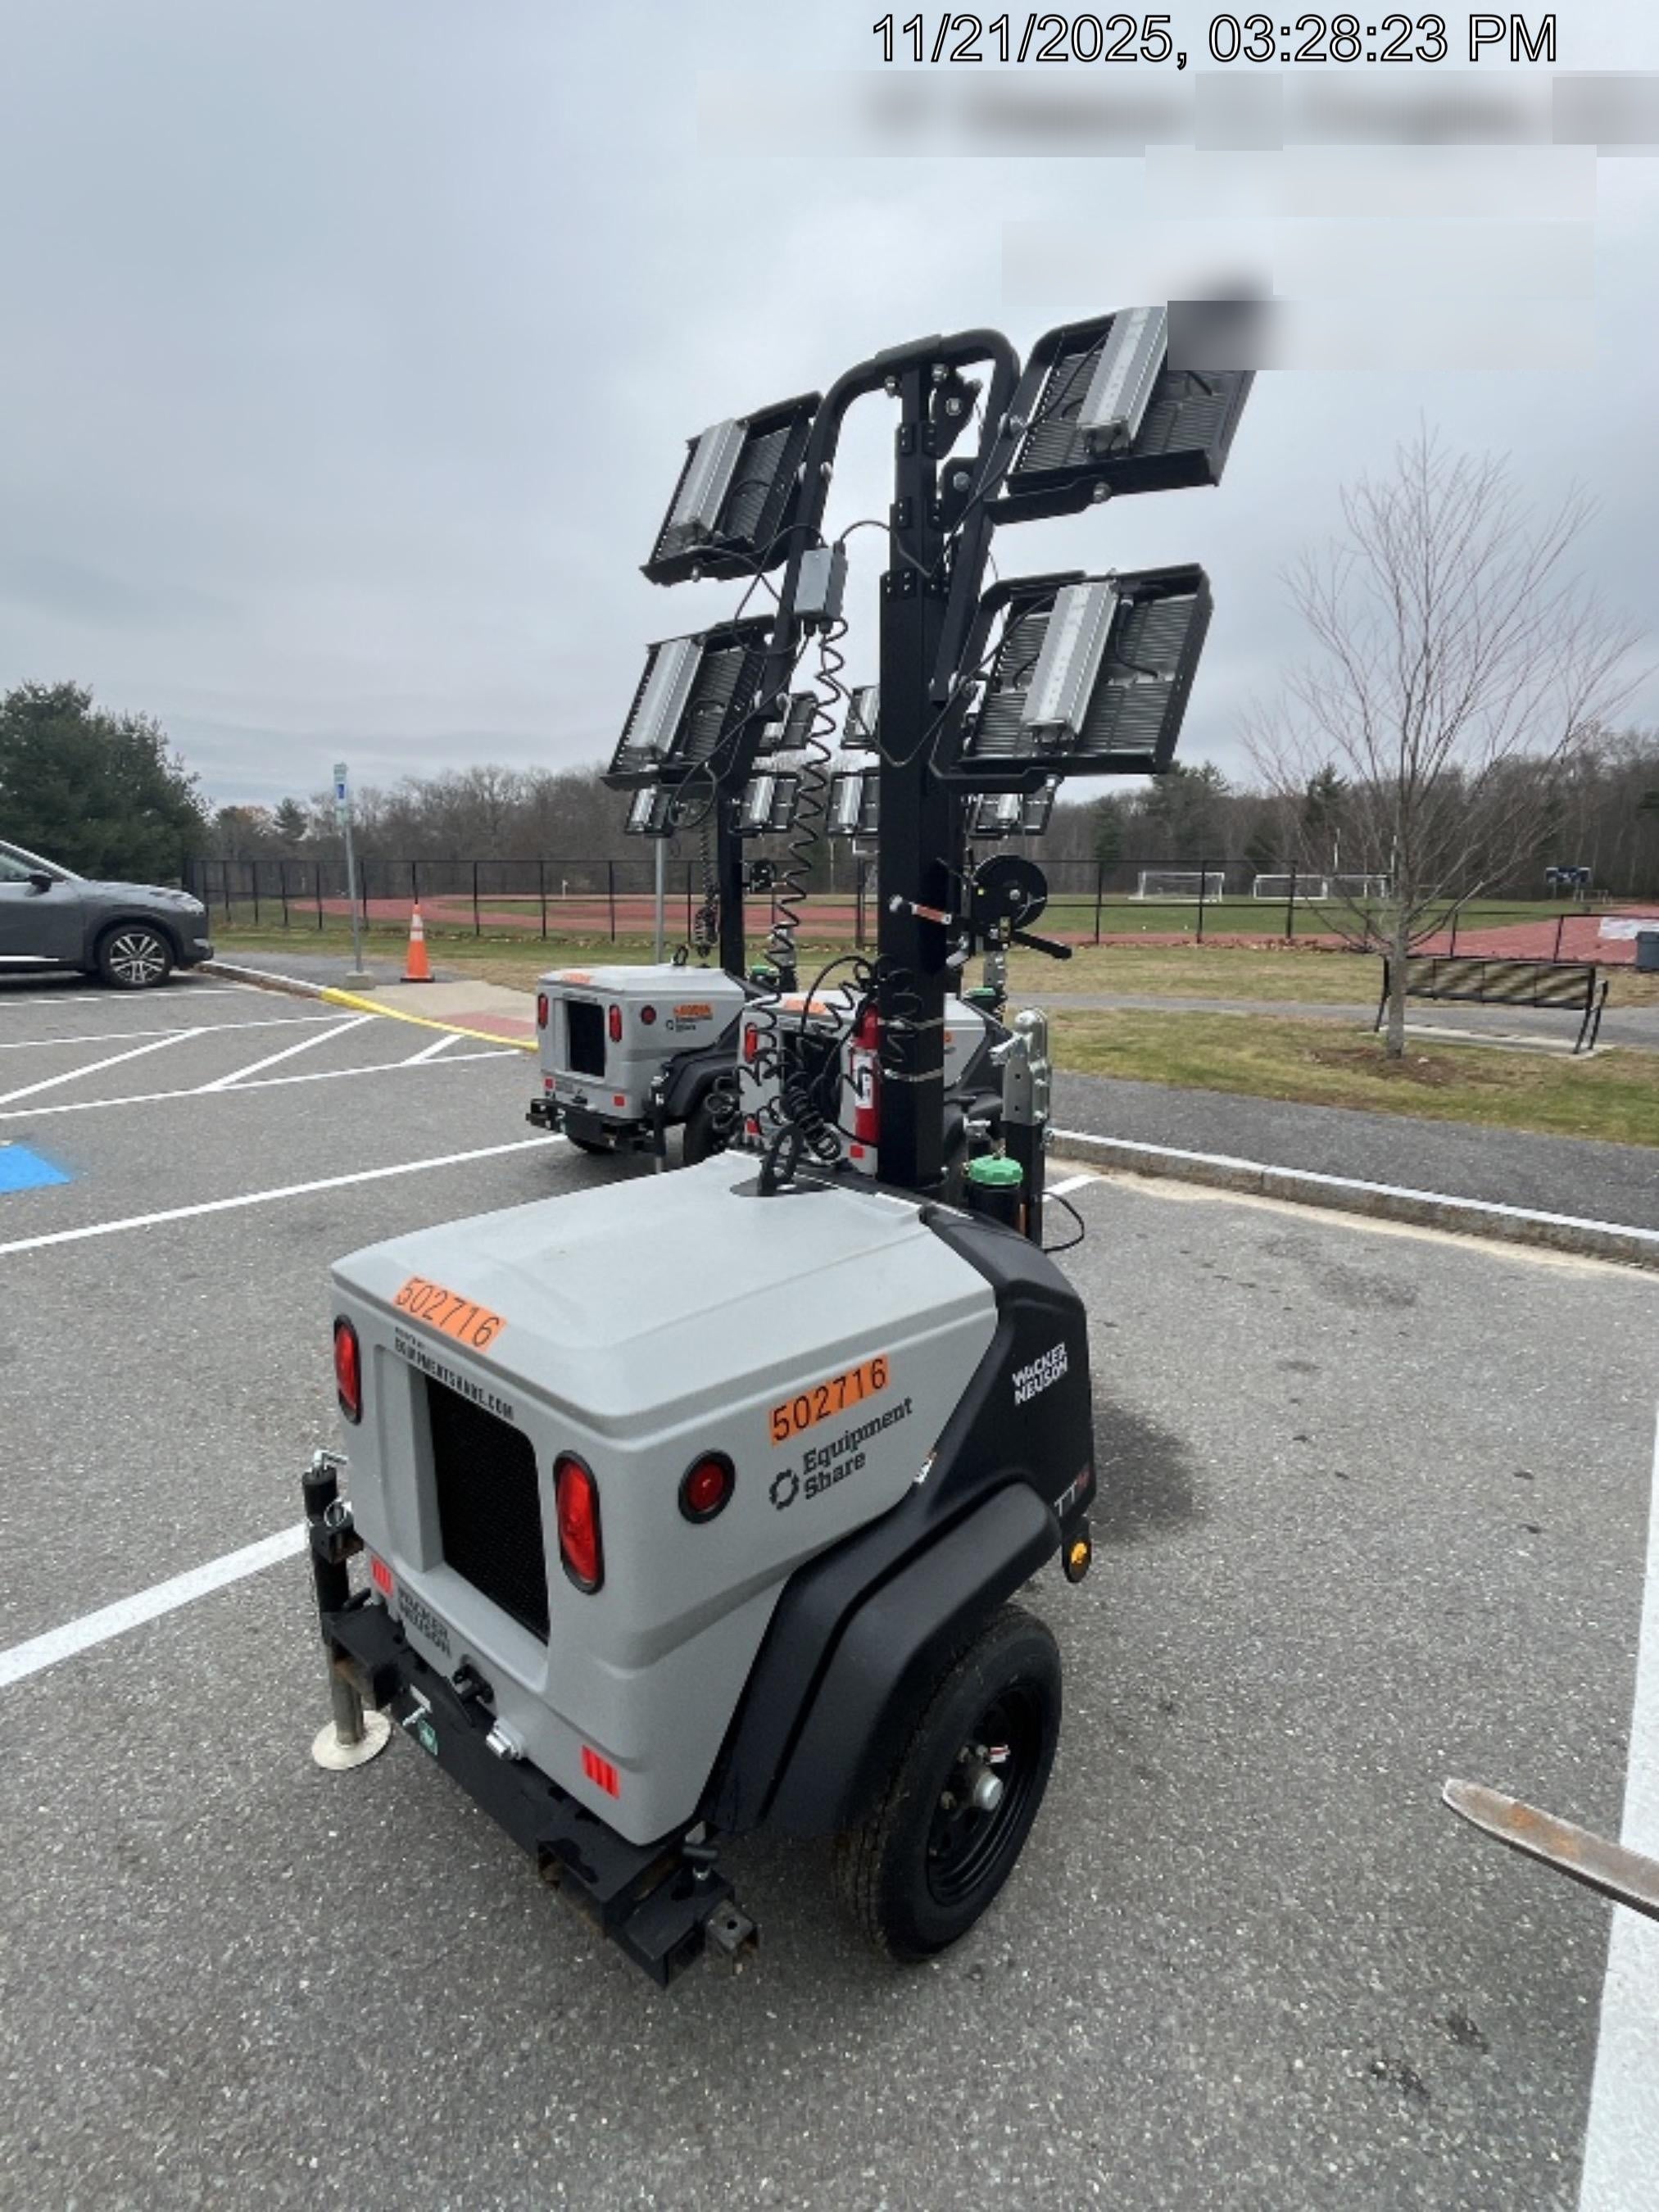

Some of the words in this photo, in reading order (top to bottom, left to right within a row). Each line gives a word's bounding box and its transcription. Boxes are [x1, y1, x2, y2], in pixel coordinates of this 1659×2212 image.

[396, 1276, 500, 1348] 502716
[1012, 1341, 1067, 1388] WACKER
[1014, 1356, 1068, 1407] NEUSON
[773, 1358, 886, 1442] 502716
[803, 1396, 913, 1475] Equipment
[804, 1452, 867, 1500] Share
